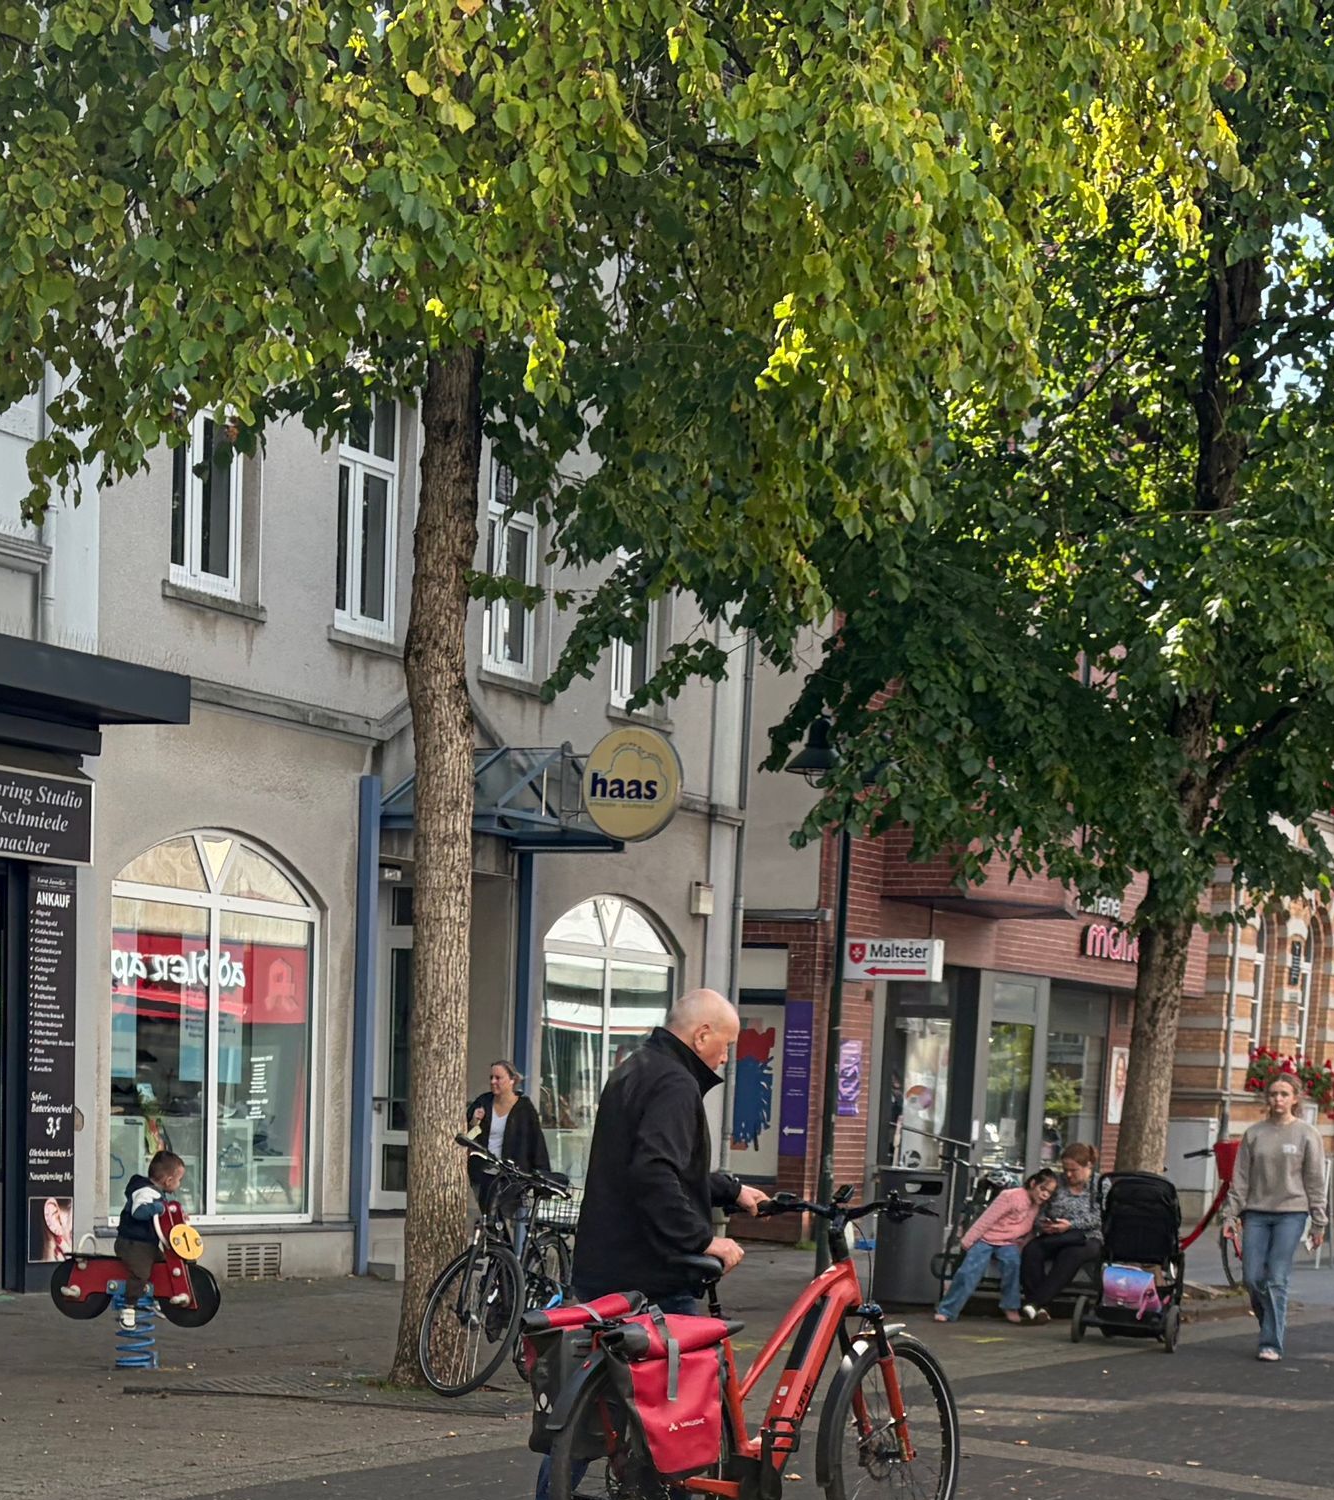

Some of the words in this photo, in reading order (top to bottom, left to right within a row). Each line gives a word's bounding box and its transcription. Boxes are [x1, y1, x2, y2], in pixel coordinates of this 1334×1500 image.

[590, 772, 658, 800] haas
[36, 785, 83, 809] Studio
[36, 891, 71, 908] ANKAUF
[870, 943, 928, 958] Malteser
